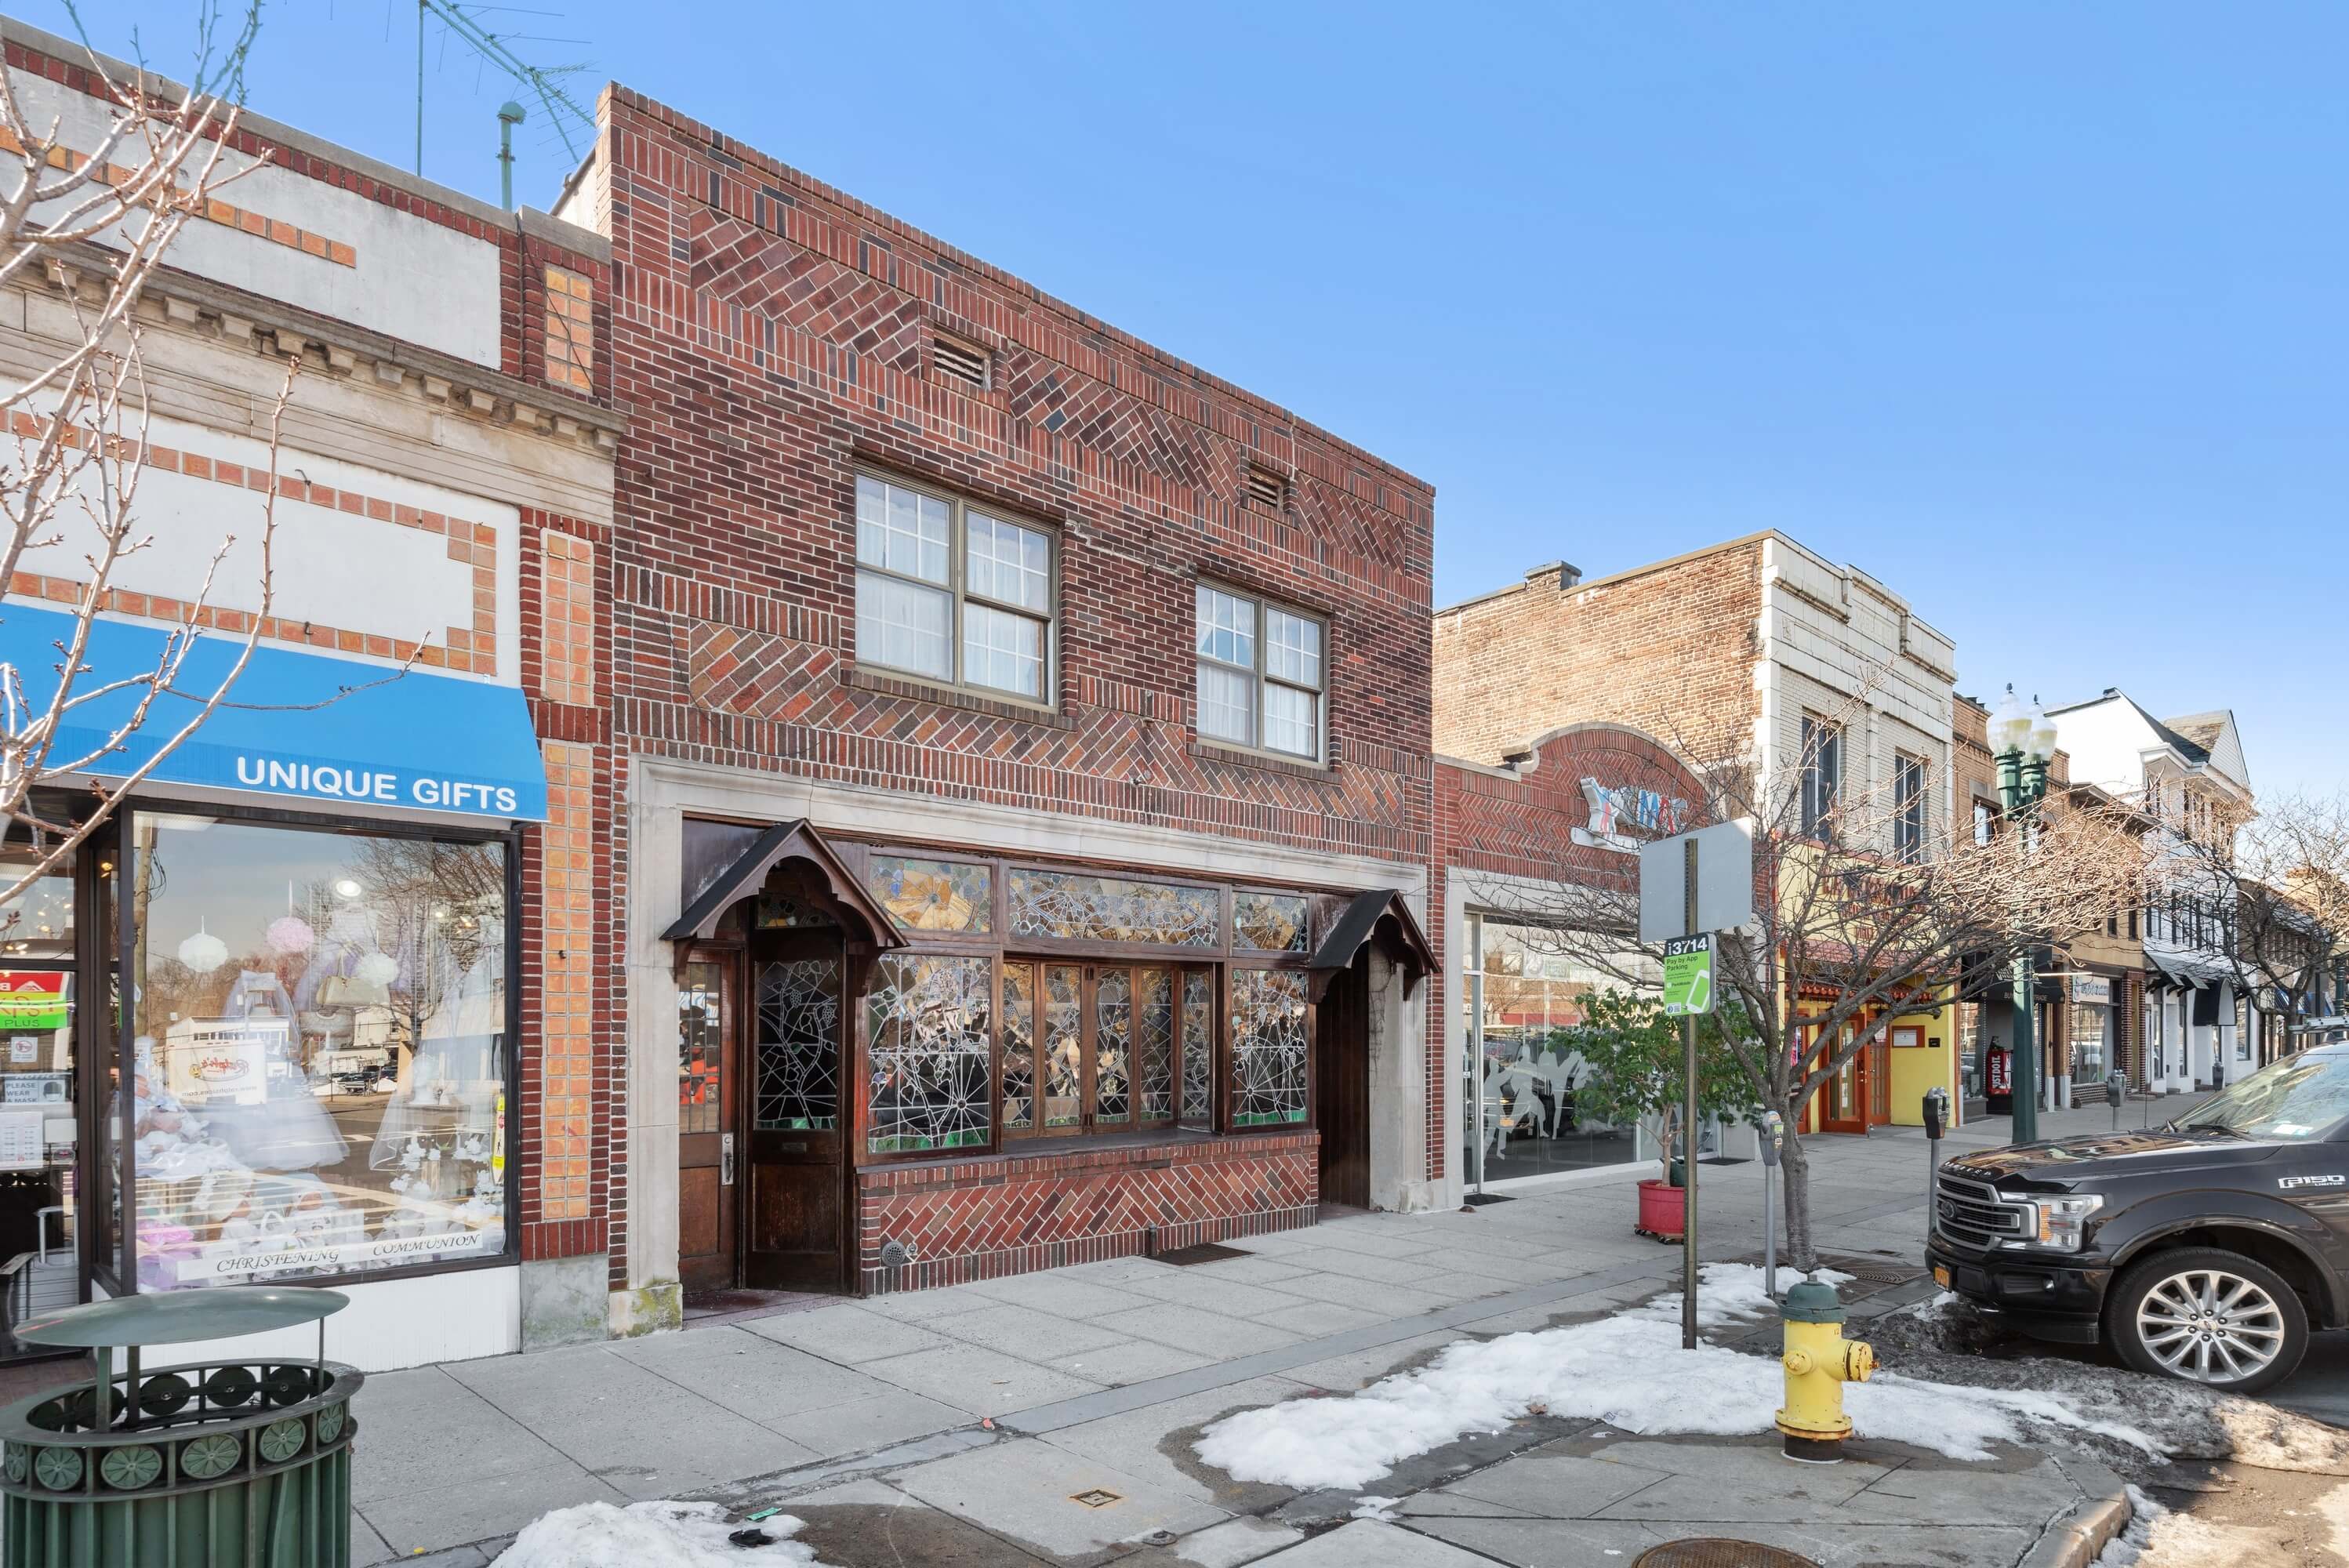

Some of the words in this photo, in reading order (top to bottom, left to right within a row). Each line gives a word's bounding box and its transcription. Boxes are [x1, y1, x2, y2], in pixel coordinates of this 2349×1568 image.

[238, 757, 397, 800] UNIQUE
[412, 779, 517, 812] GIFTS
[1668, 938, 1708, 956] i3714
[216, 1248, 339, 1272] CHRISTENING
[373, 1235, 480, 1255] COMMUNION
